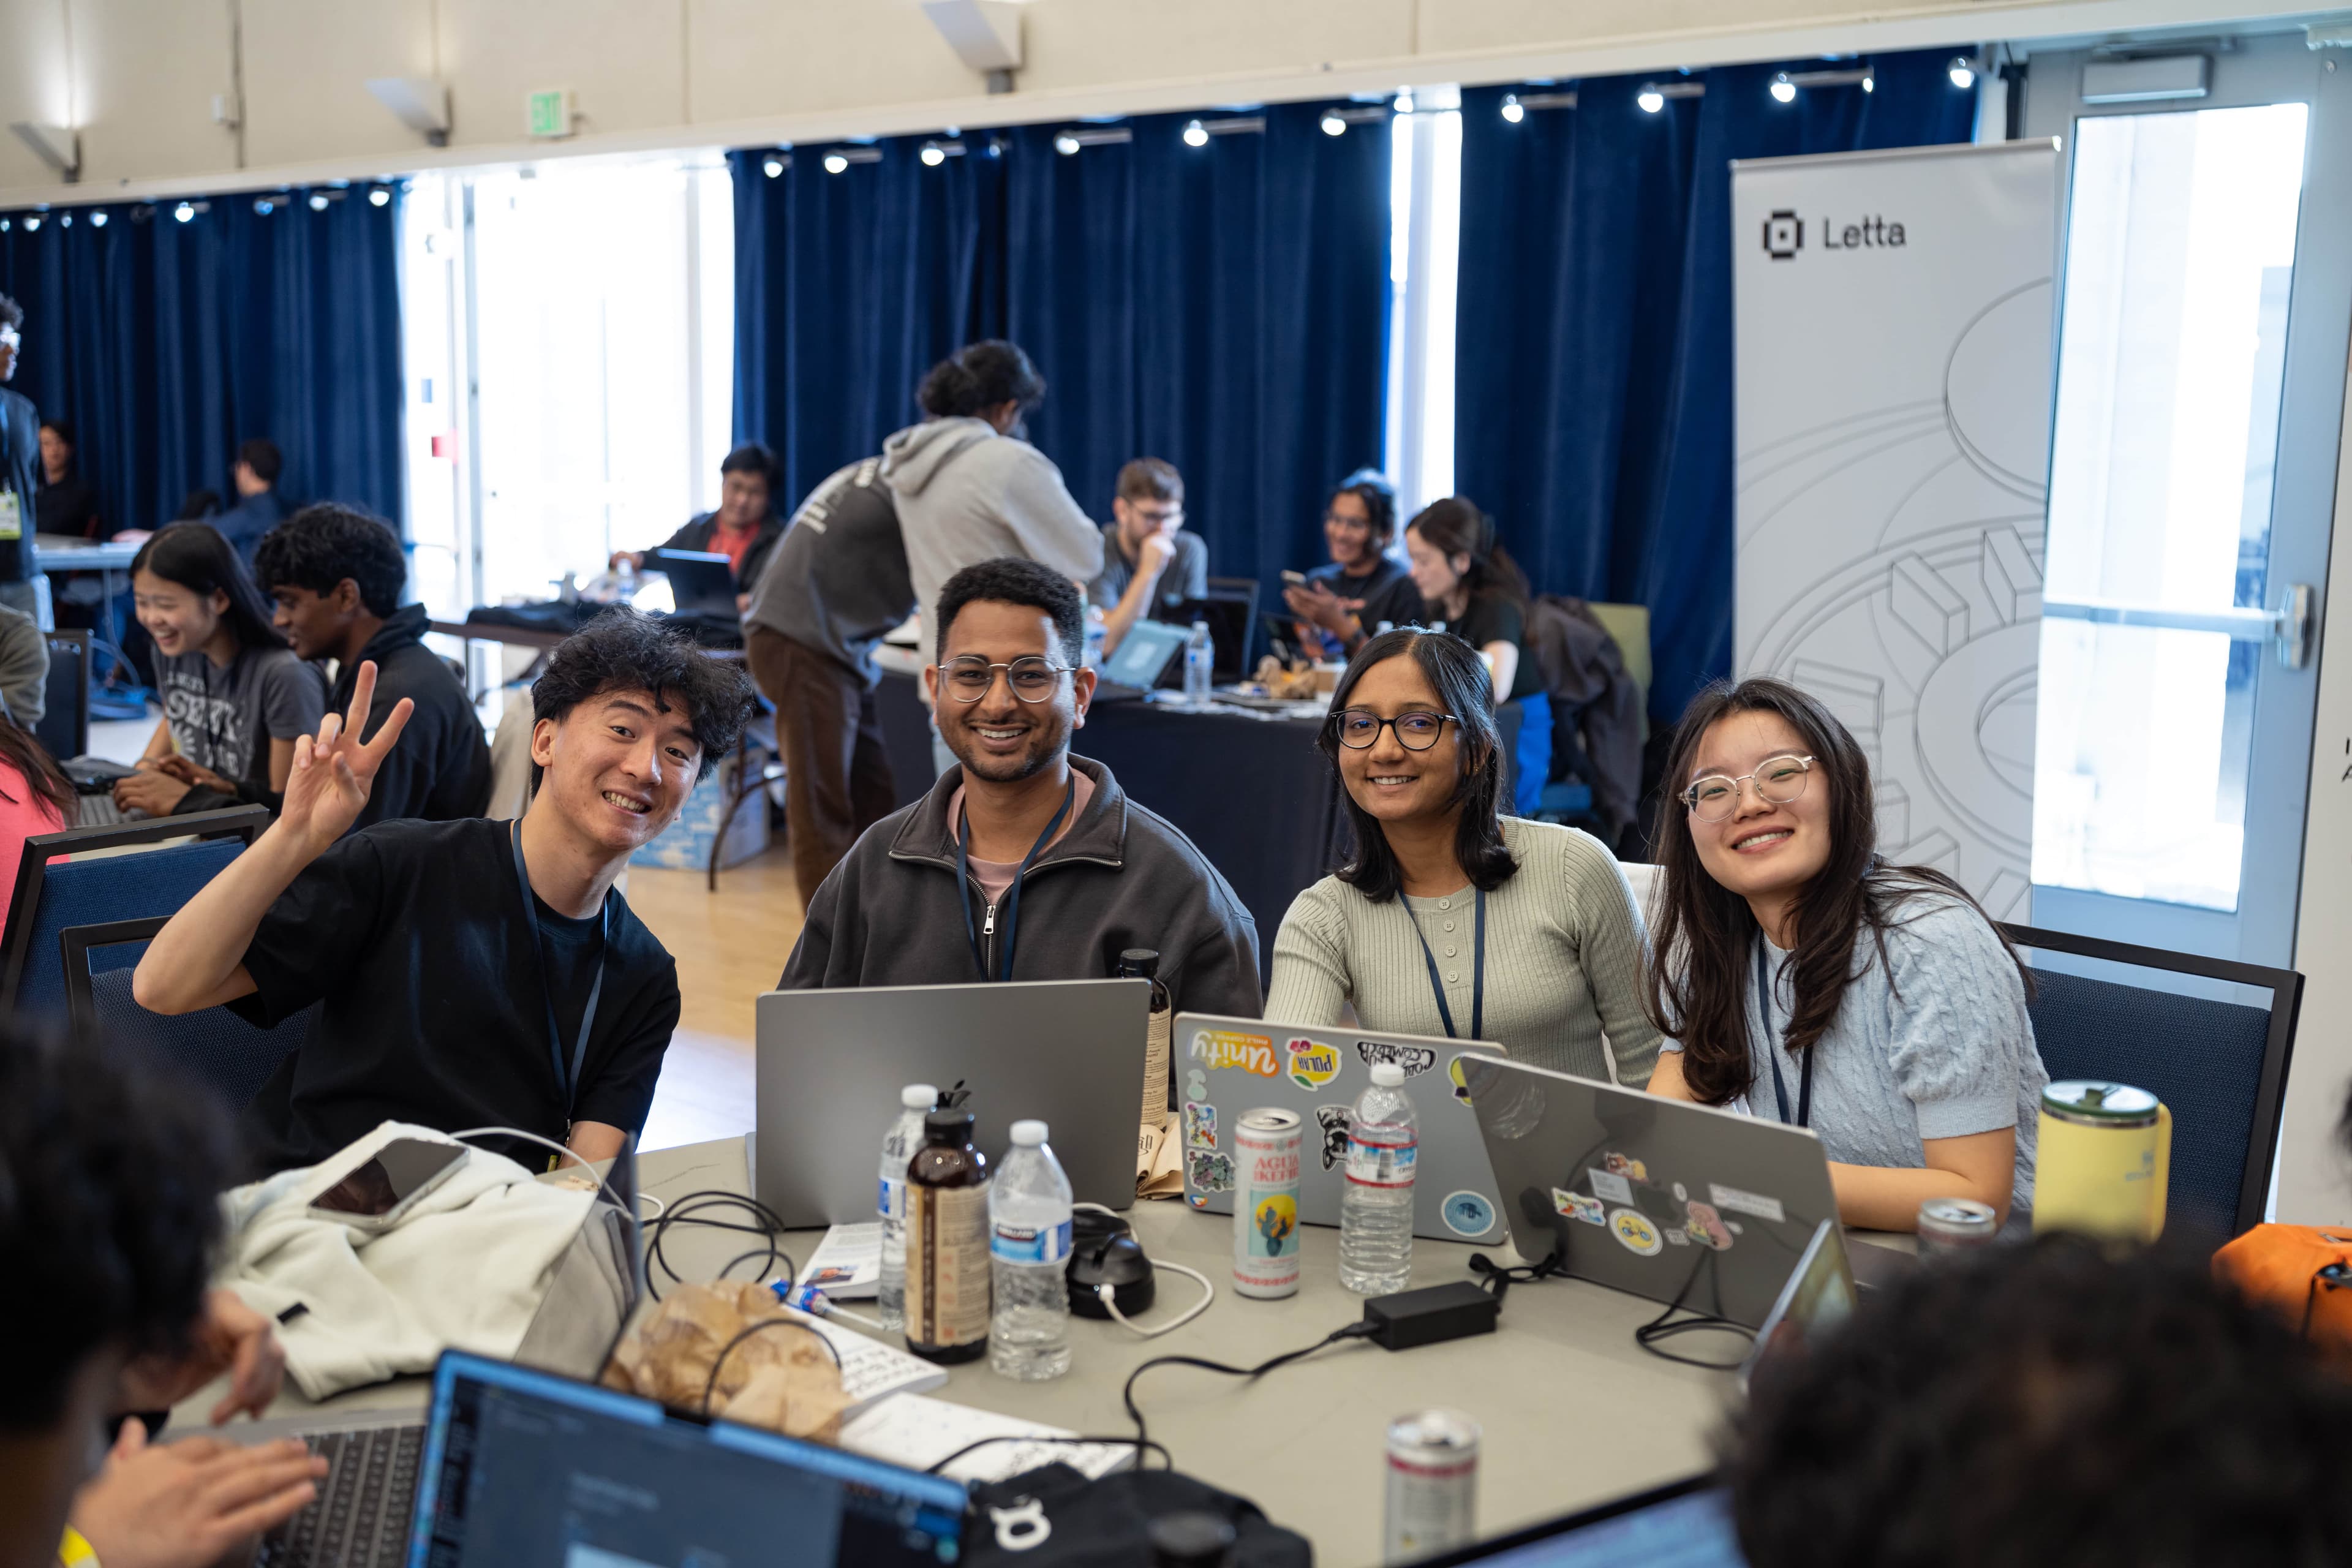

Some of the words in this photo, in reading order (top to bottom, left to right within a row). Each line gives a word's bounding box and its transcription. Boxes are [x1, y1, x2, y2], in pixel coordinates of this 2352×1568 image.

[1823, 214, 1907, 248] Letta
[1191, 1031, 1276, 1073] Unity
[1298, 1054, 1333, 1072] POLAR
[1254, 1154, 1298, 1170] AGUA
